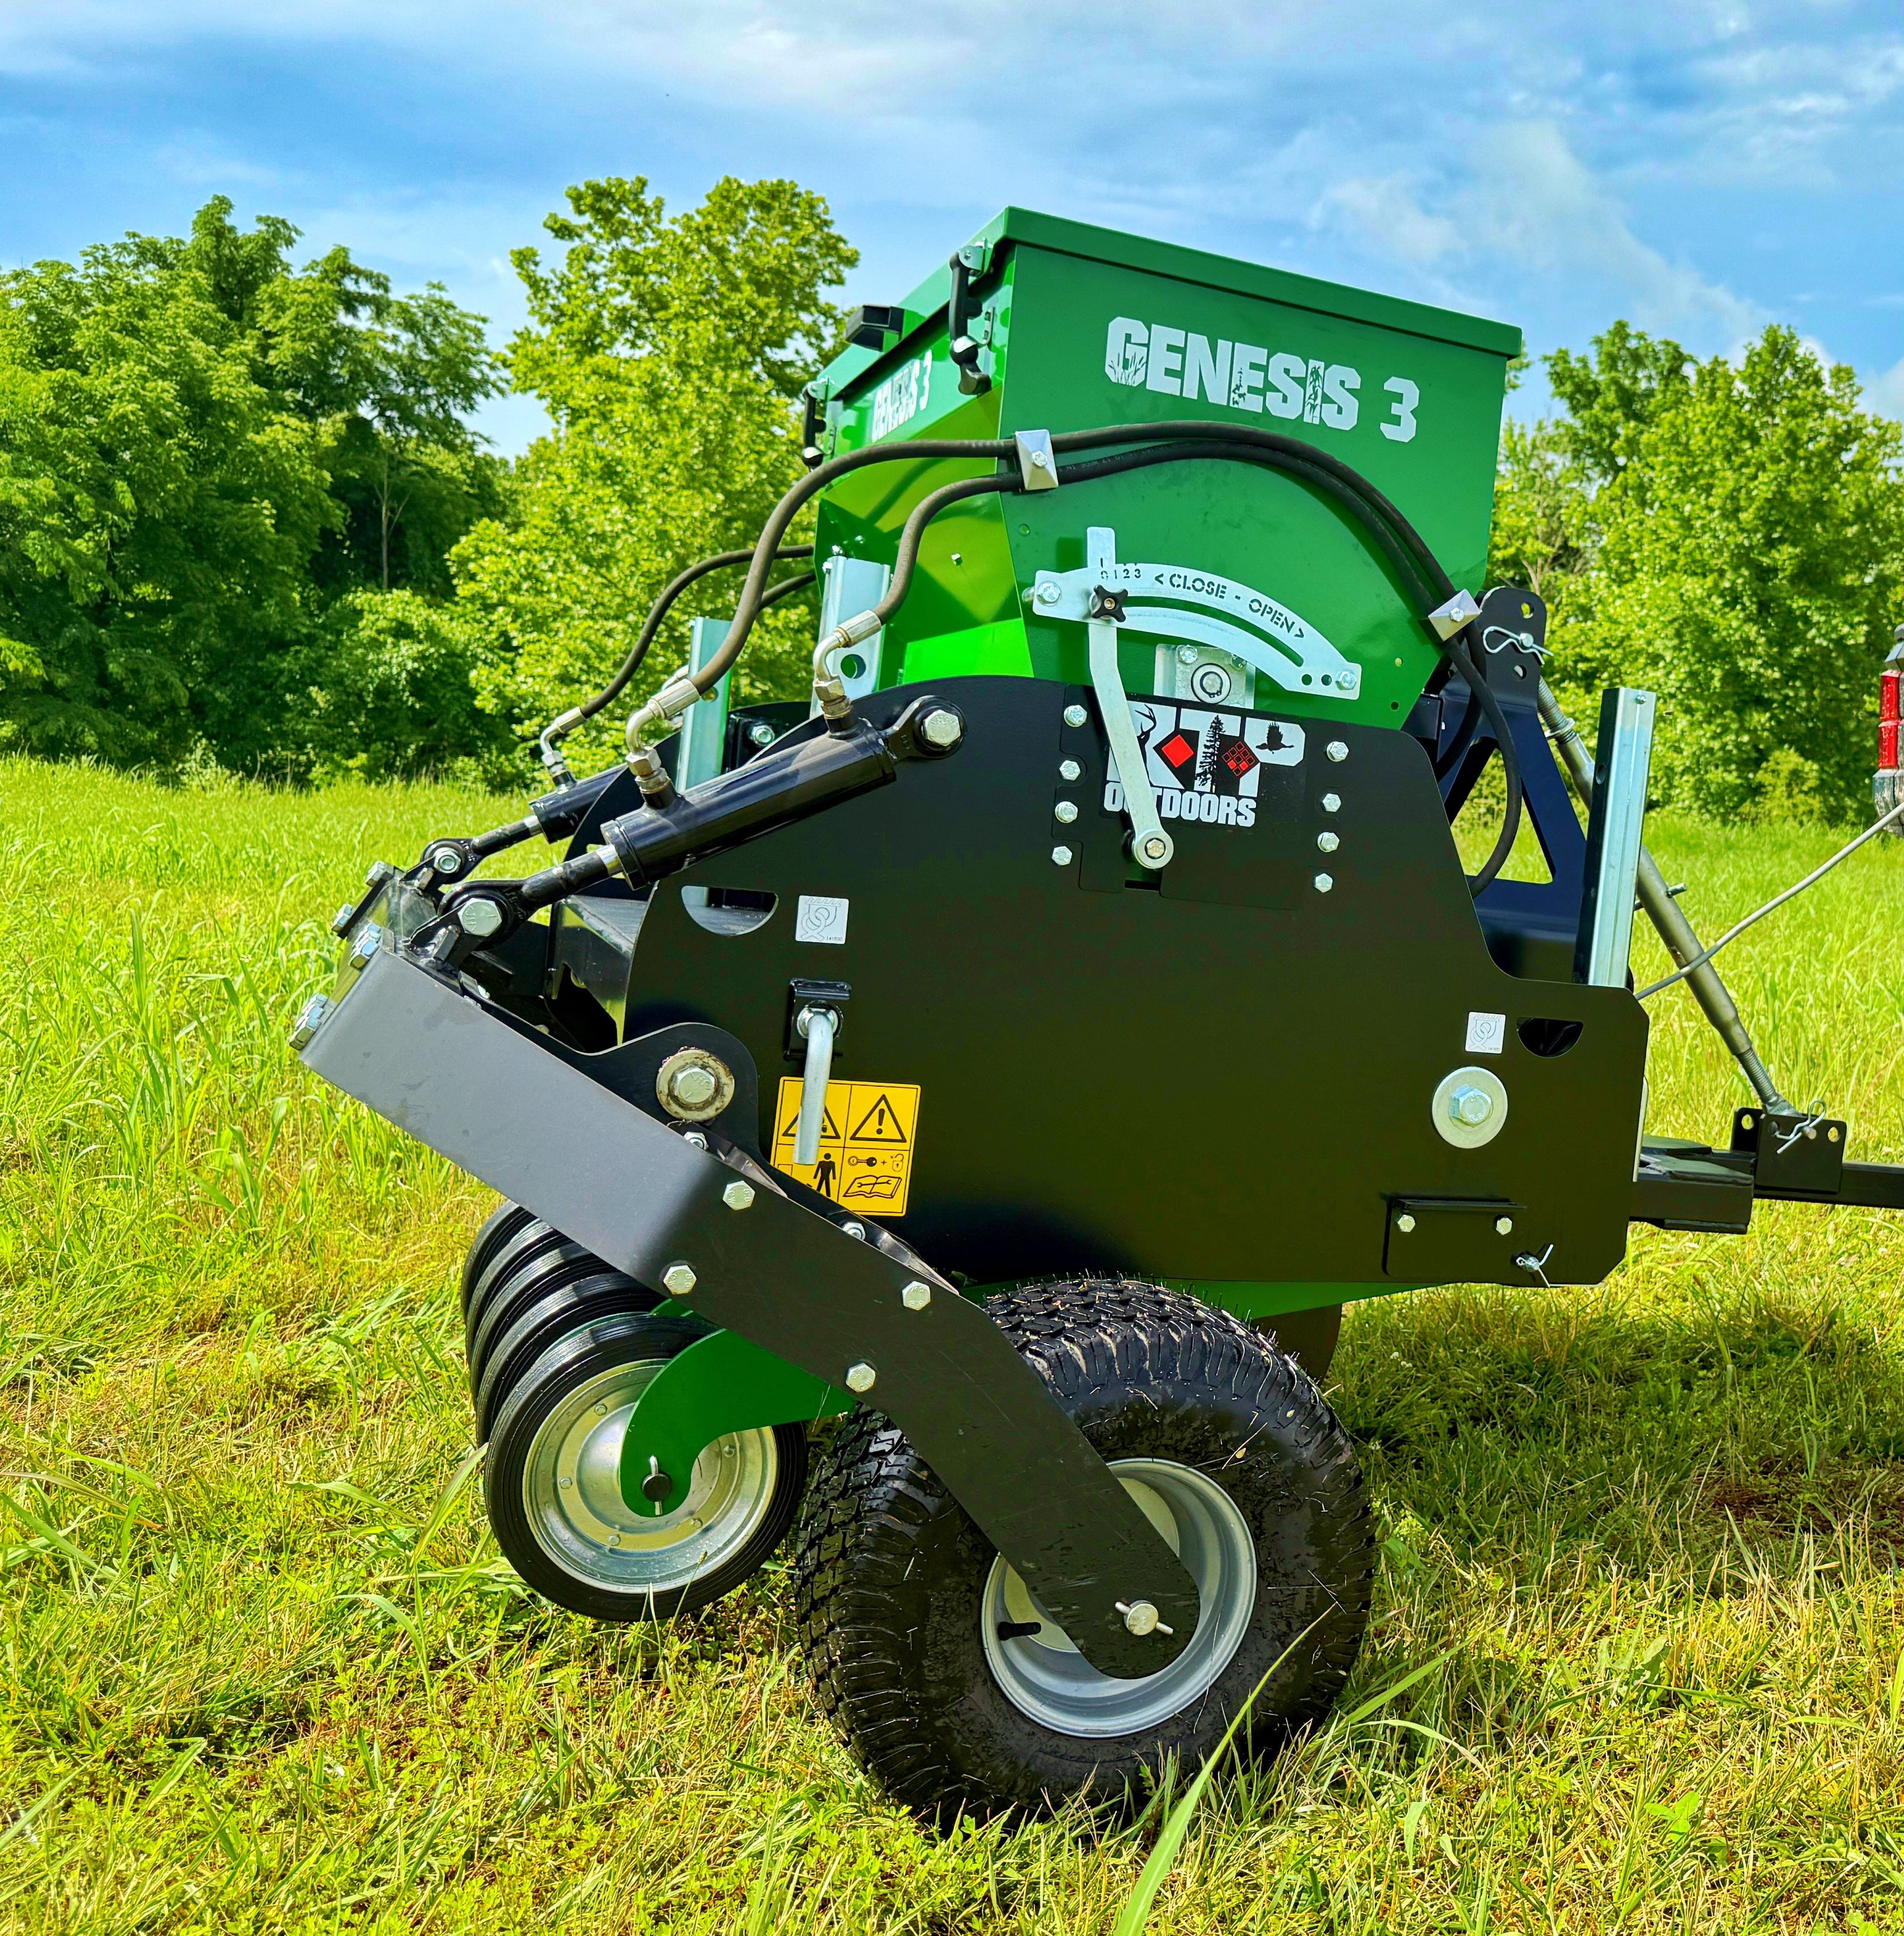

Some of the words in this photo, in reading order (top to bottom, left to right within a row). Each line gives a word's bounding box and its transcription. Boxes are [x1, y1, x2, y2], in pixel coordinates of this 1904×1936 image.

[871, 359, 921, 443] GENESIS
[919, 349, 932, 411] 3
[1105, 316, 1361, 431] GENESIS
[1380, 376, 1419, 443] 3
[1104, 781, 1257, 828] ODOORS
